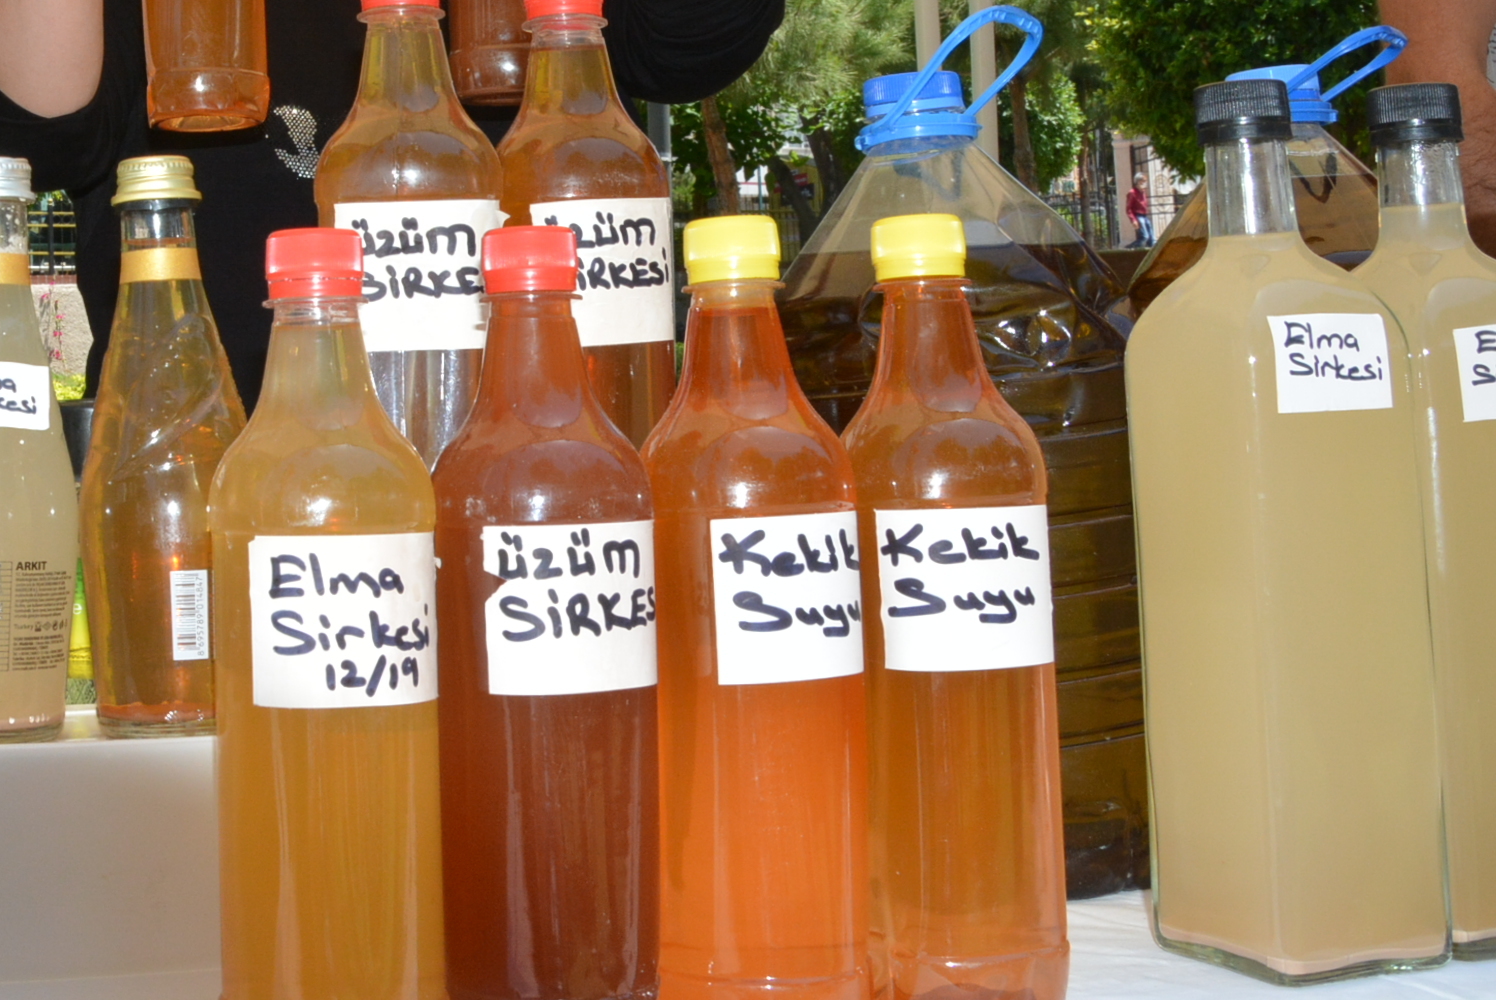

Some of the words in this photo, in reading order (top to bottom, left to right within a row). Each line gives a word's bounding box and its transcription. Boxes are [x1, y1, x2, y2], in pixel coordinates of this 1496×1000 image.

[1284, 321, 1360, 352] Elma
[1288, 352, 1383, 381] Sirkesi
[15, 561, 47, 571] ARKIT
[880, 522, 1040, 567] Kekik
[268, 552, 404, 599] Elma
[499, 586, 655, 642] SİRKES
[732, 591, 861, 637] Suyu
[887, 577, 1035, 624] Suyu
[271, 603, 429, 656] Sirkesi
[325, 654, 418, 697] 12/19
